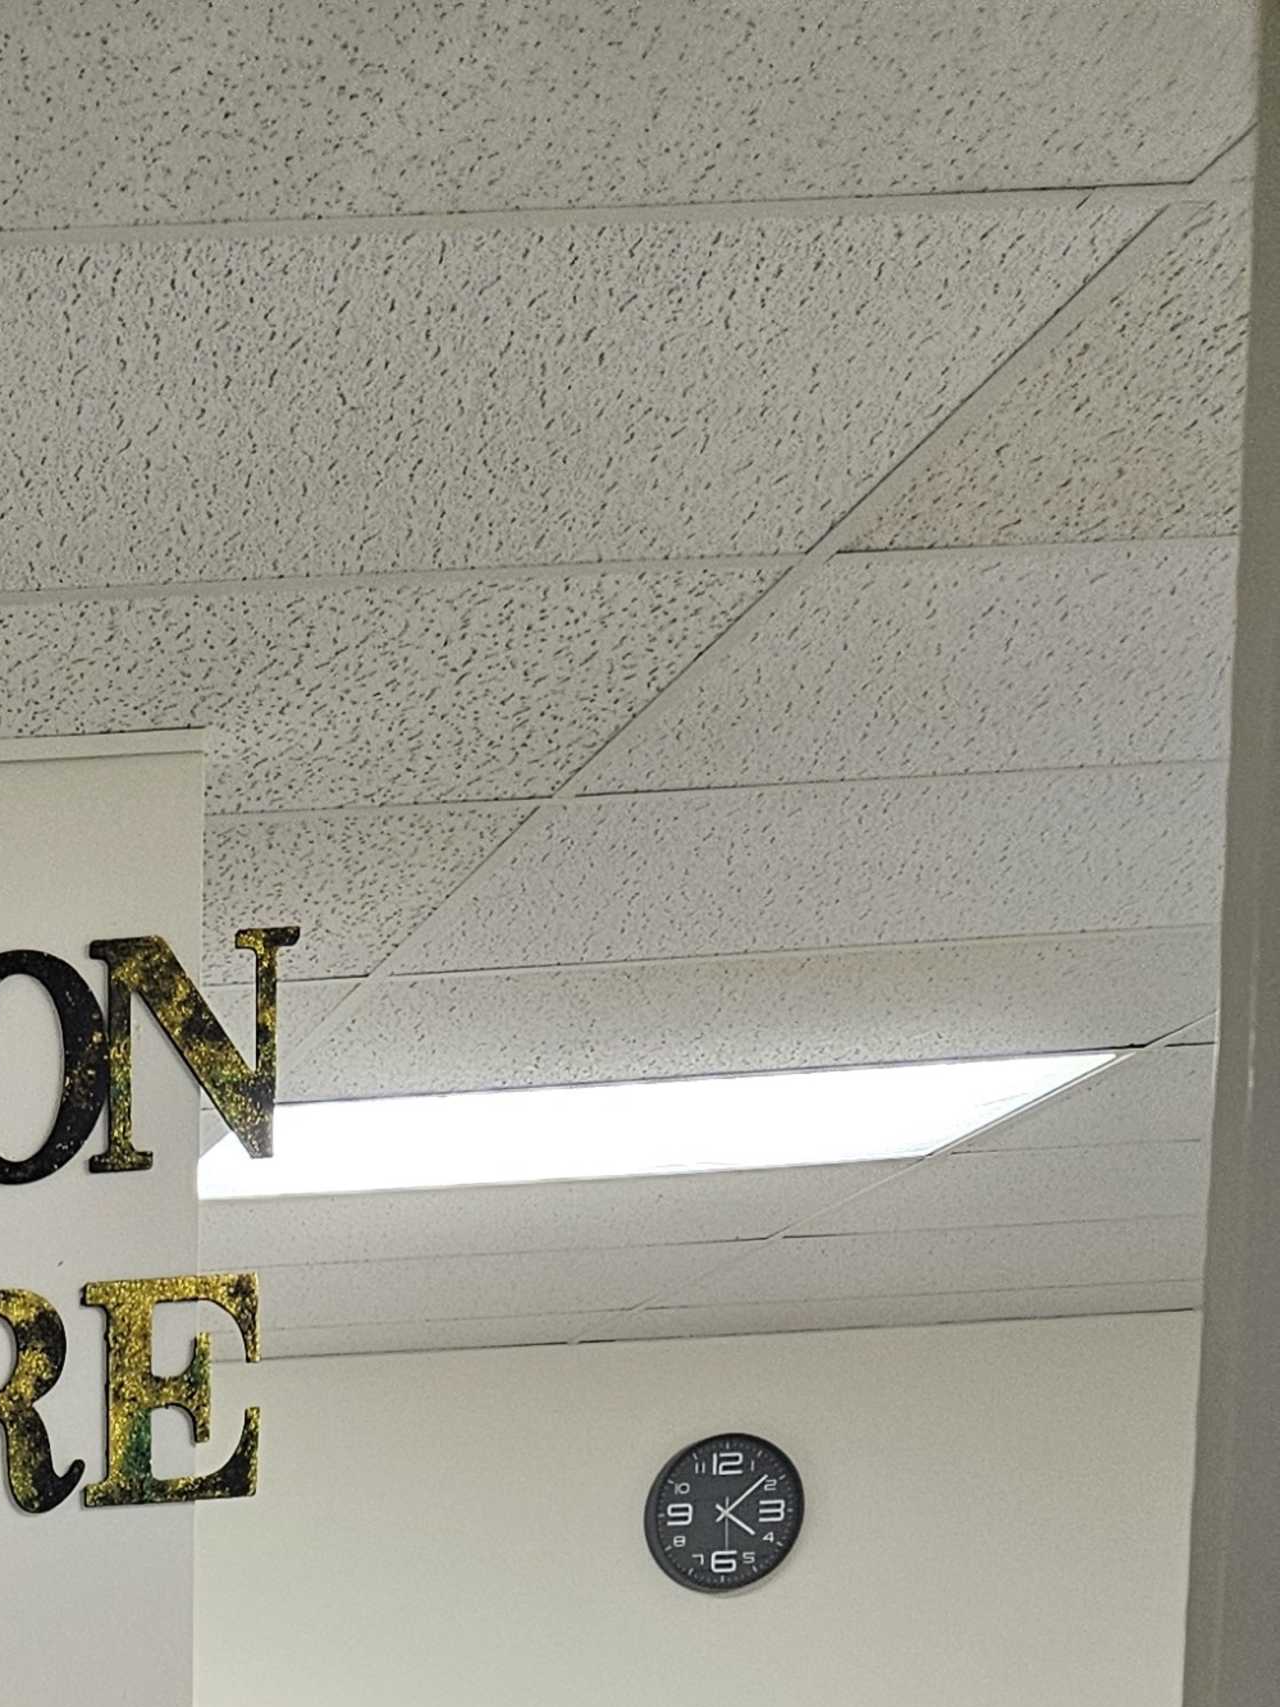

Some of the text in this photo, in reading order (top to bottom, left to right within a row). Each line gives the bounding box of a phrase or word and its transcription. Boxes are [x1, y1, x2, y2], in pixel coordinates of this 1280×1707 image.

[694, 1461, 706, 1474] 11
[712, 1452, 743, 1475] 12
[674, 1482, 690, 1495] 10
[763, 1479, 777, 1492] 2
[666, 1503, 693, 1526] 9
[758, 1499, 786, 1522] 3
[673, 1535, 686, 1548] 8
[762, 1532, 775, 1543] 4
[691, 1553, 705, 1566] 7
[710, 1550, 738, 1573] 6
[742, 1552, 756, 1564] 5
